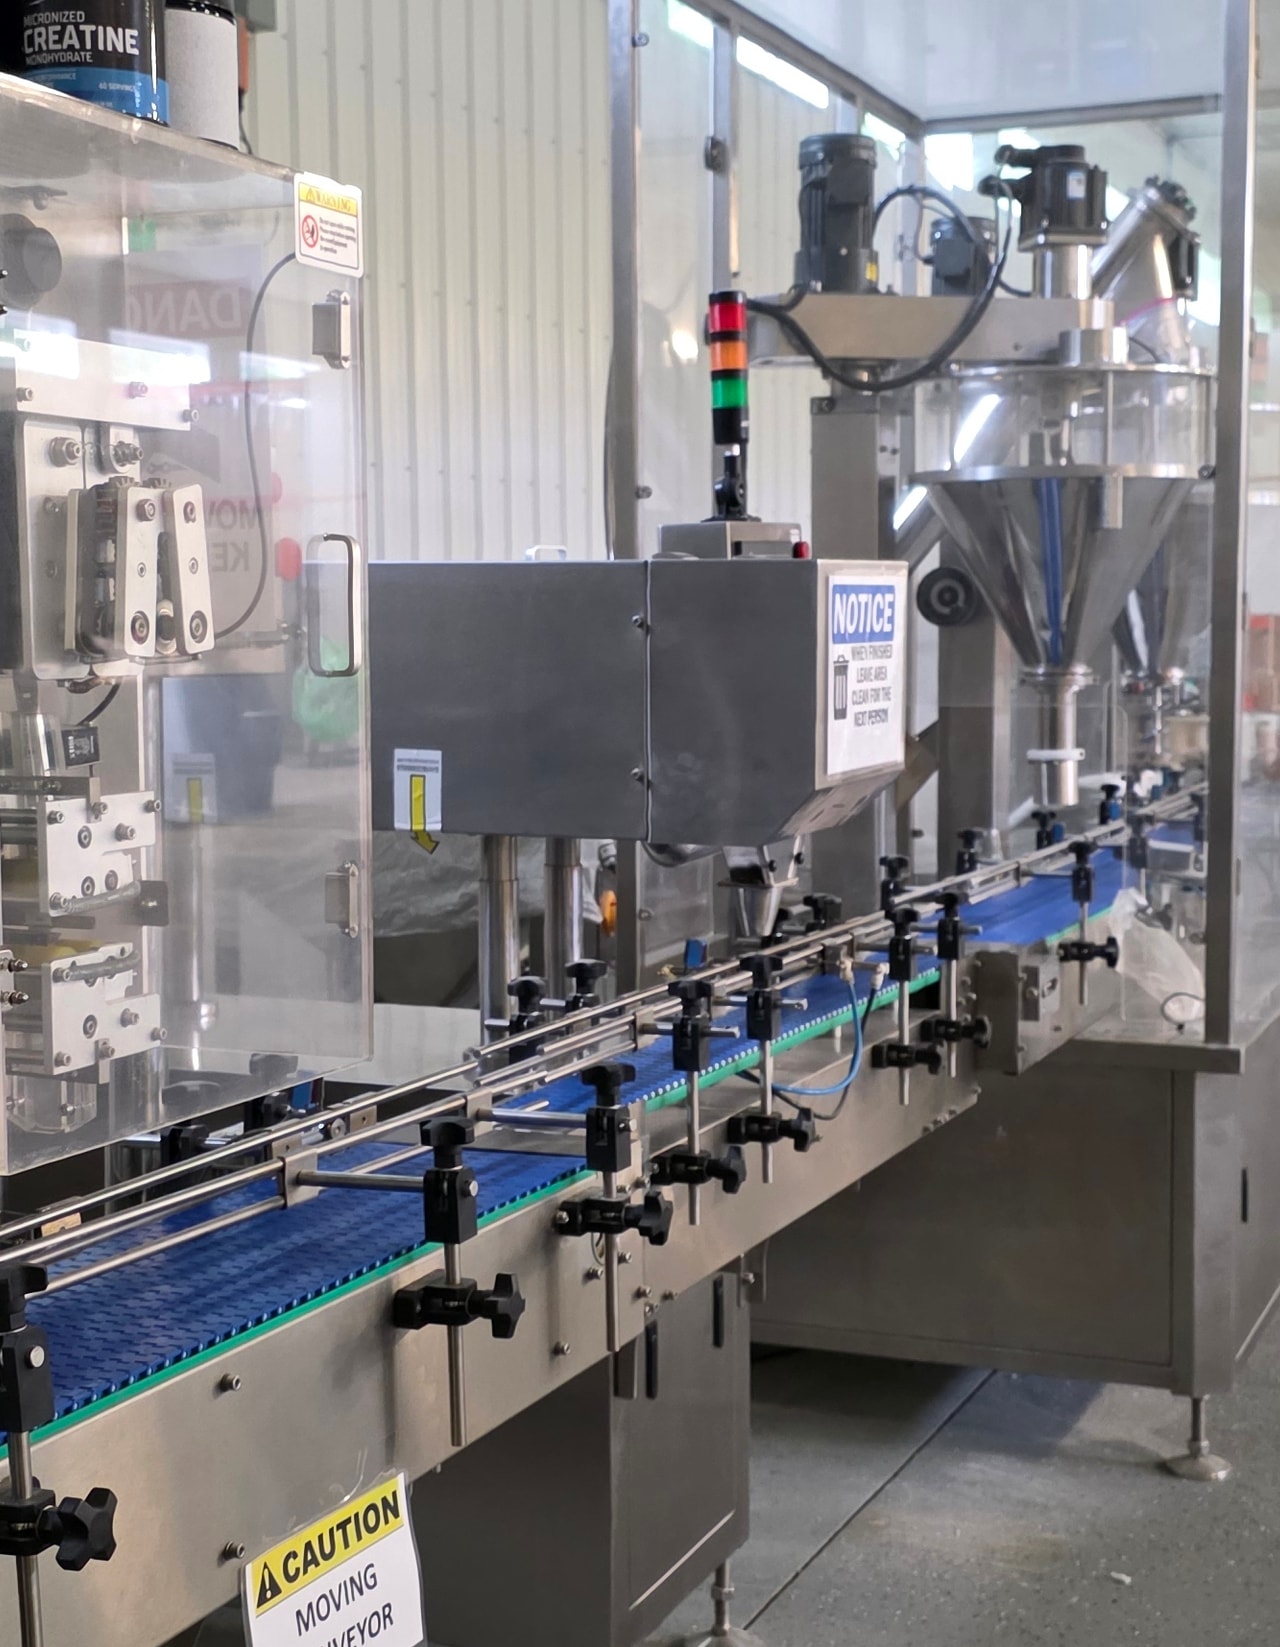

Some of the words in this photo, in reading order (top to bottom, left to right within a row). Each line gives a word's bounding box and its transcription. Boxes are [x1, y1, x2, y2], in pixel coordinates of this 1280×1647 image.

[24, 11, 85, 27] MICRONIZED
[24, 25, 139, 55] CREATINE
[26, 52, 93, 65] MONOHYDRATE
[834, 593, 894, 634] NOTICE
[851, 646, 868, 661] WHEN
[856, 667, 873, 683] LEAVE
[874, 666, 888, 681] AREA
[852, 689, 869, 705] CLEAN
[854, 711, 867, 727] NEXT
[868, 708, 888, 726] PERSON
[282, 1490, 400, 1584] CAUTION
[295, 1563, 378, 1637] MOVING
